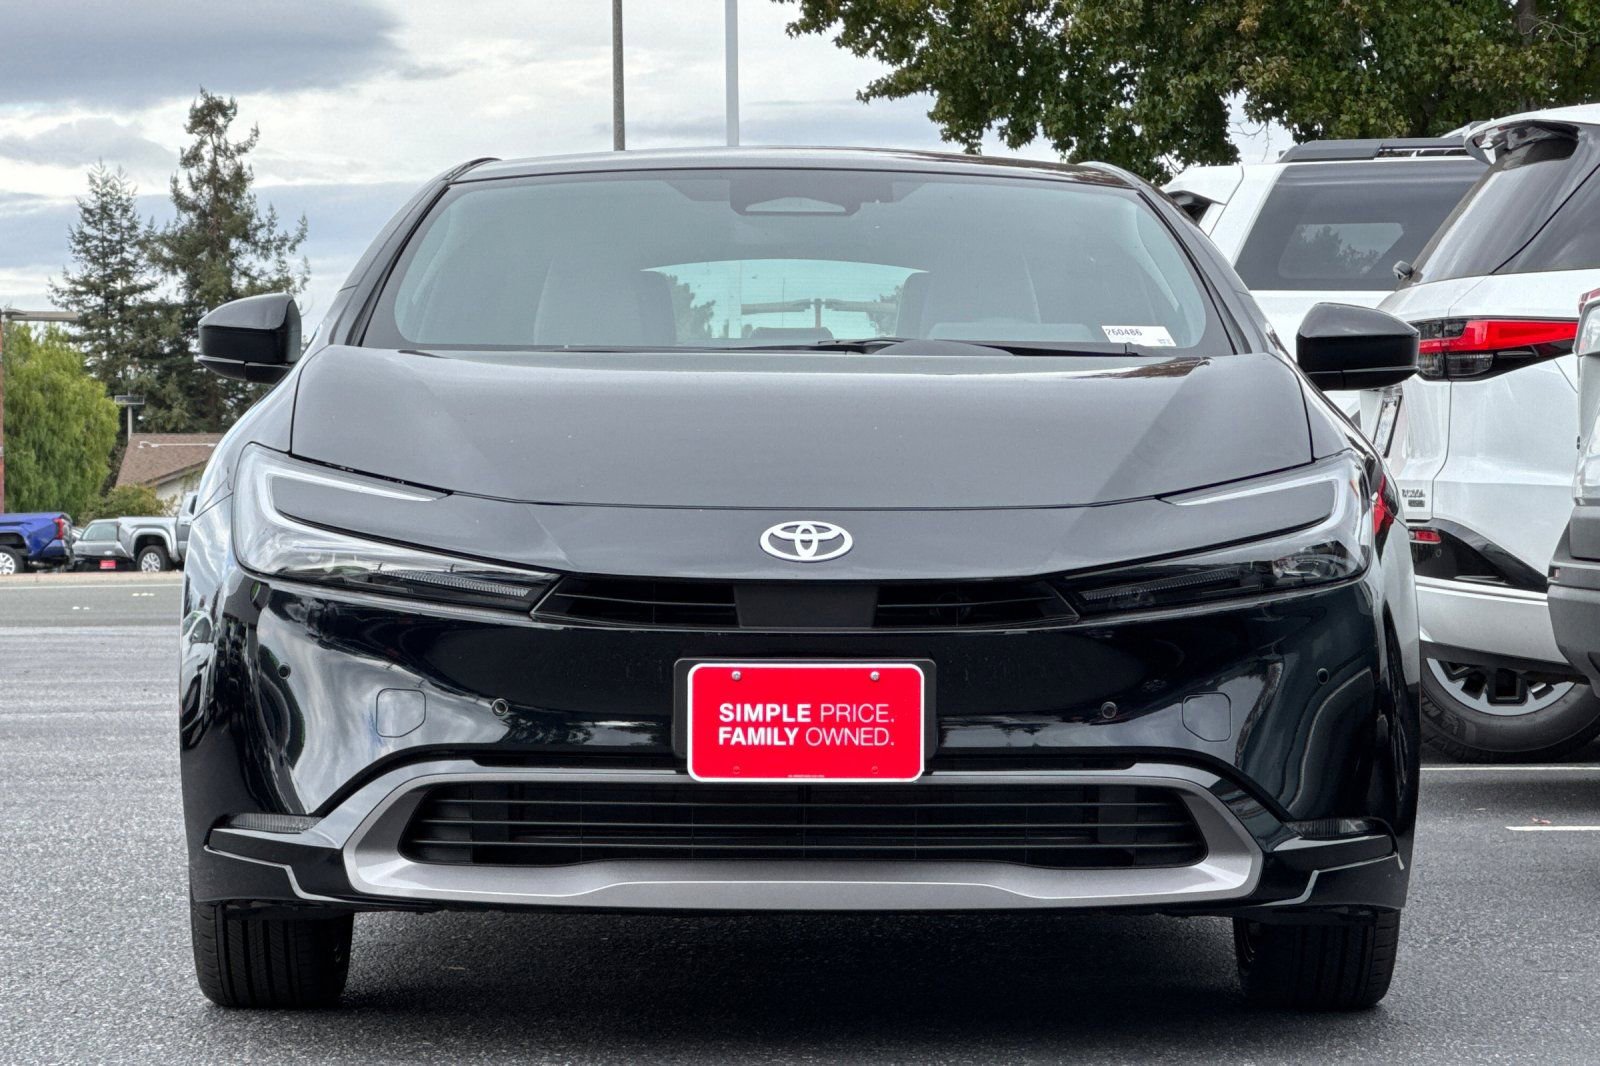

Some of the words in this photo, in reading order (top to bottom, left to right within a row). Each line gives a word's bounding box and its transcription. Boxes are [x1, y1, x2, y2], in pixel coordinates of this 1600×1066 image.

[719, 703, 812, 723] SIMPLE
[820, 703, 895, 723] PRICE.
[718, 727, 799, 746] FAMILY
[805, 727, 895, 746] OWNED.
